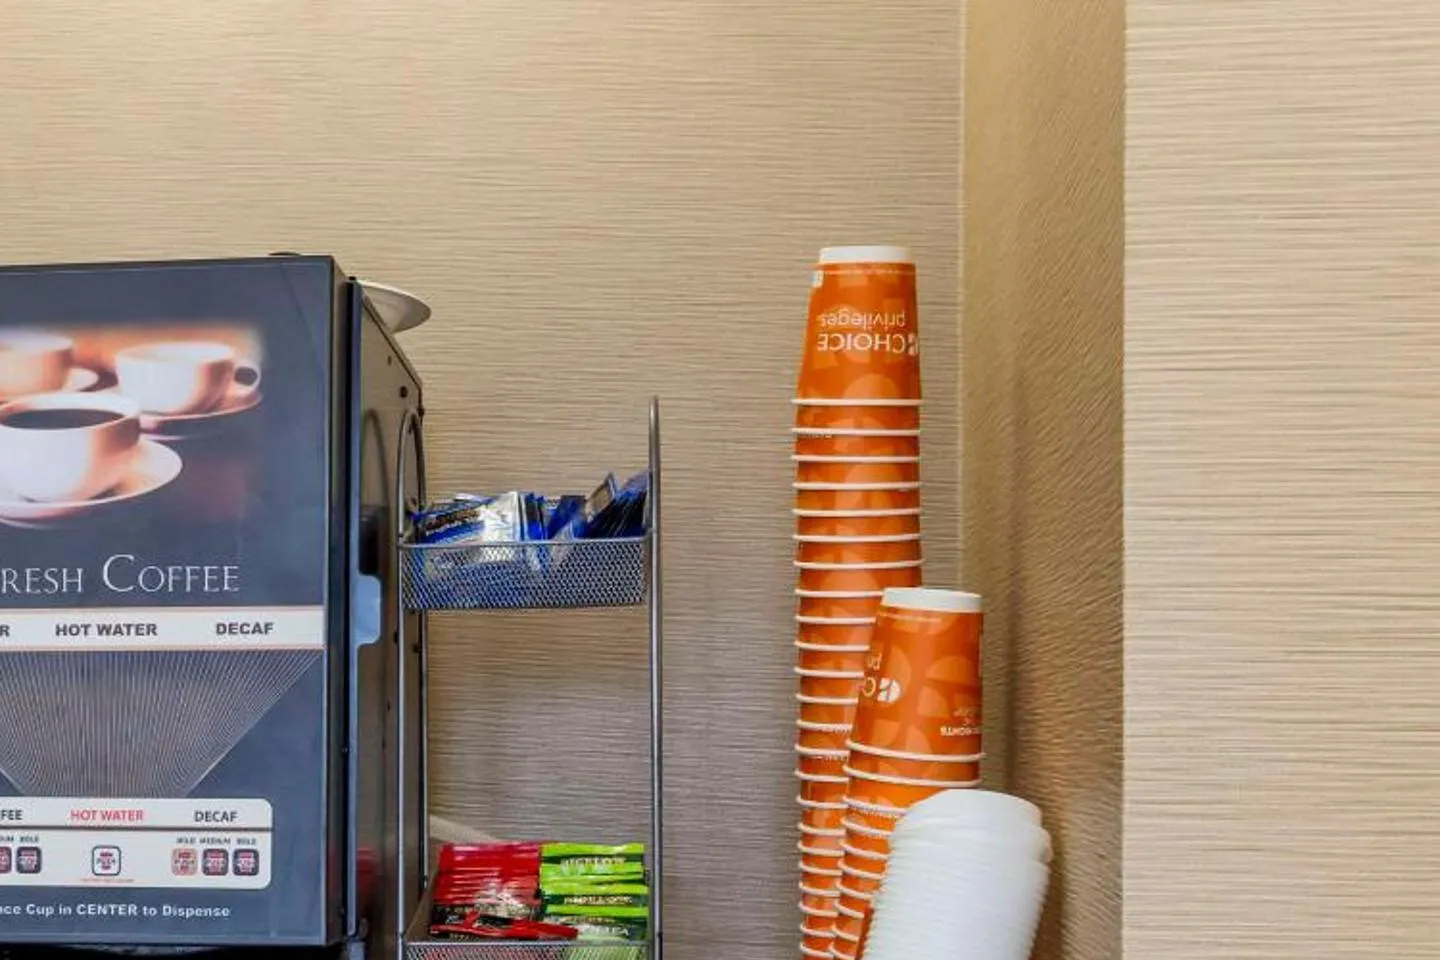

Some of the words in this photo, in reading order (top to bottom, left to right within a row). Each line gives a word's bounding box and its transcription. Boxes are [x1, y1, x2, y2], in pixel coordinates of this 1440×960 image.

[817, 309, 906, 331] privileges
[817, 333, 906, 354] CHOICE
[103, 554, 240, 593] COFFEE
[56, 624, 91, 636] HOT
[96, 623, 158, 636] WATER
[216, 622, 274, 635] DECAF
[70, 809, 97, 821] HOT
[100, 809, 145, 822] WATER
[194, 810, 239, 823] DECAF
[26, 903, 54, 917] Cup
[59, 903, 72, 915] in
[76, 904, 138, 916] CENTER
[142, 905, 157, 916] to
[162, 905, 232, 919] Dispense
